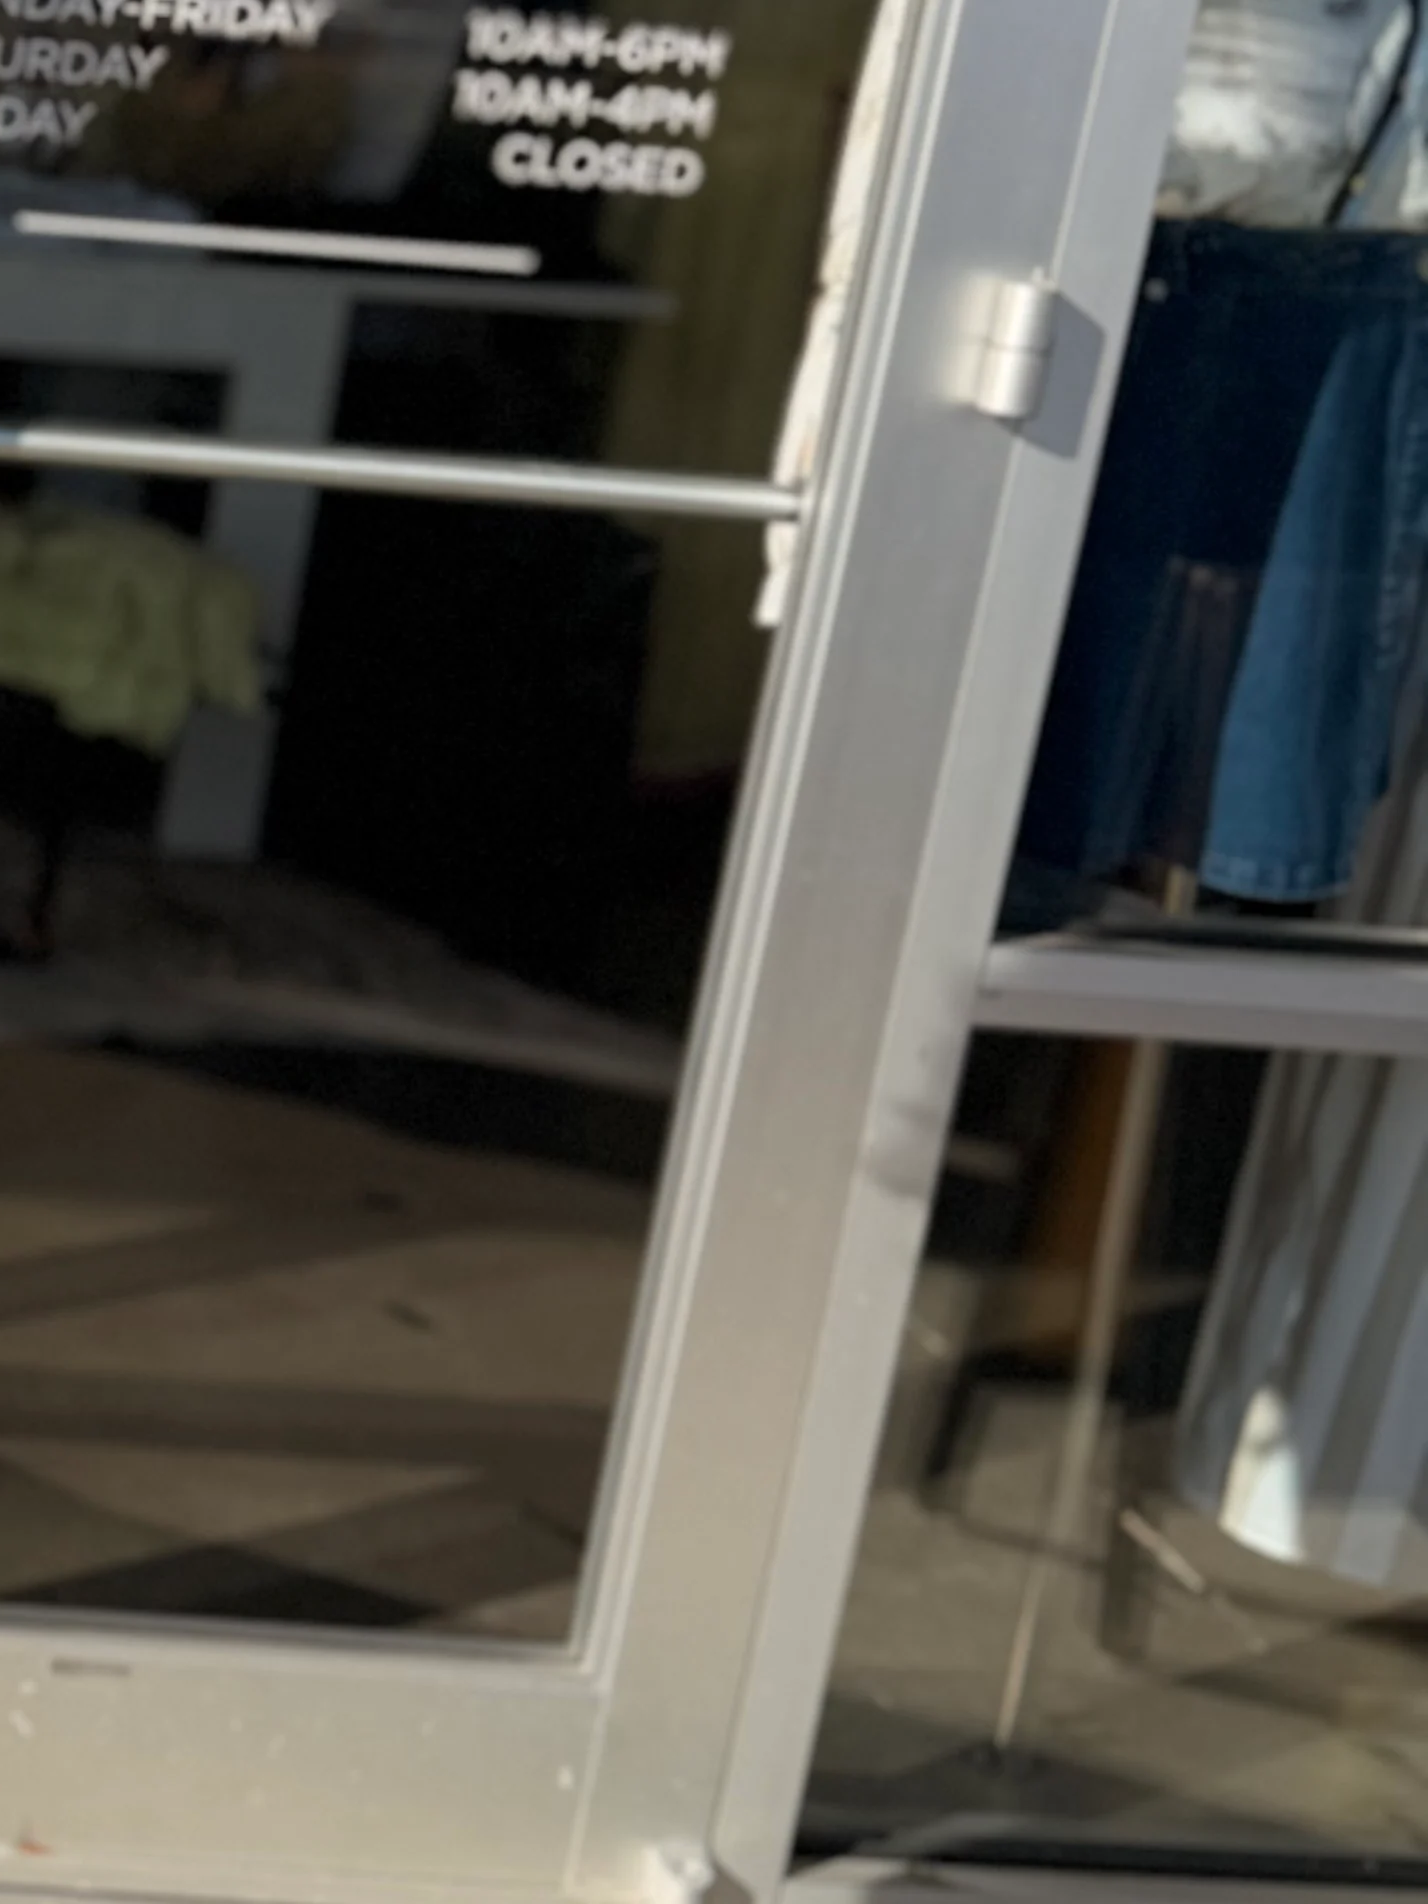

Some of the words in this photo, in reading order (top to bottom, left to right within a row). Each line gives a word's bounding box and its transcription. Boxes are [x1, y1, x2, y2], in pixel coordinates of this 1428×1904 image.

[464, 6, 732, 81] 10AM-6PM
[452, 67, 719, 140] 10AM-4PM
[490, 130, 706, 198] CLOSED
